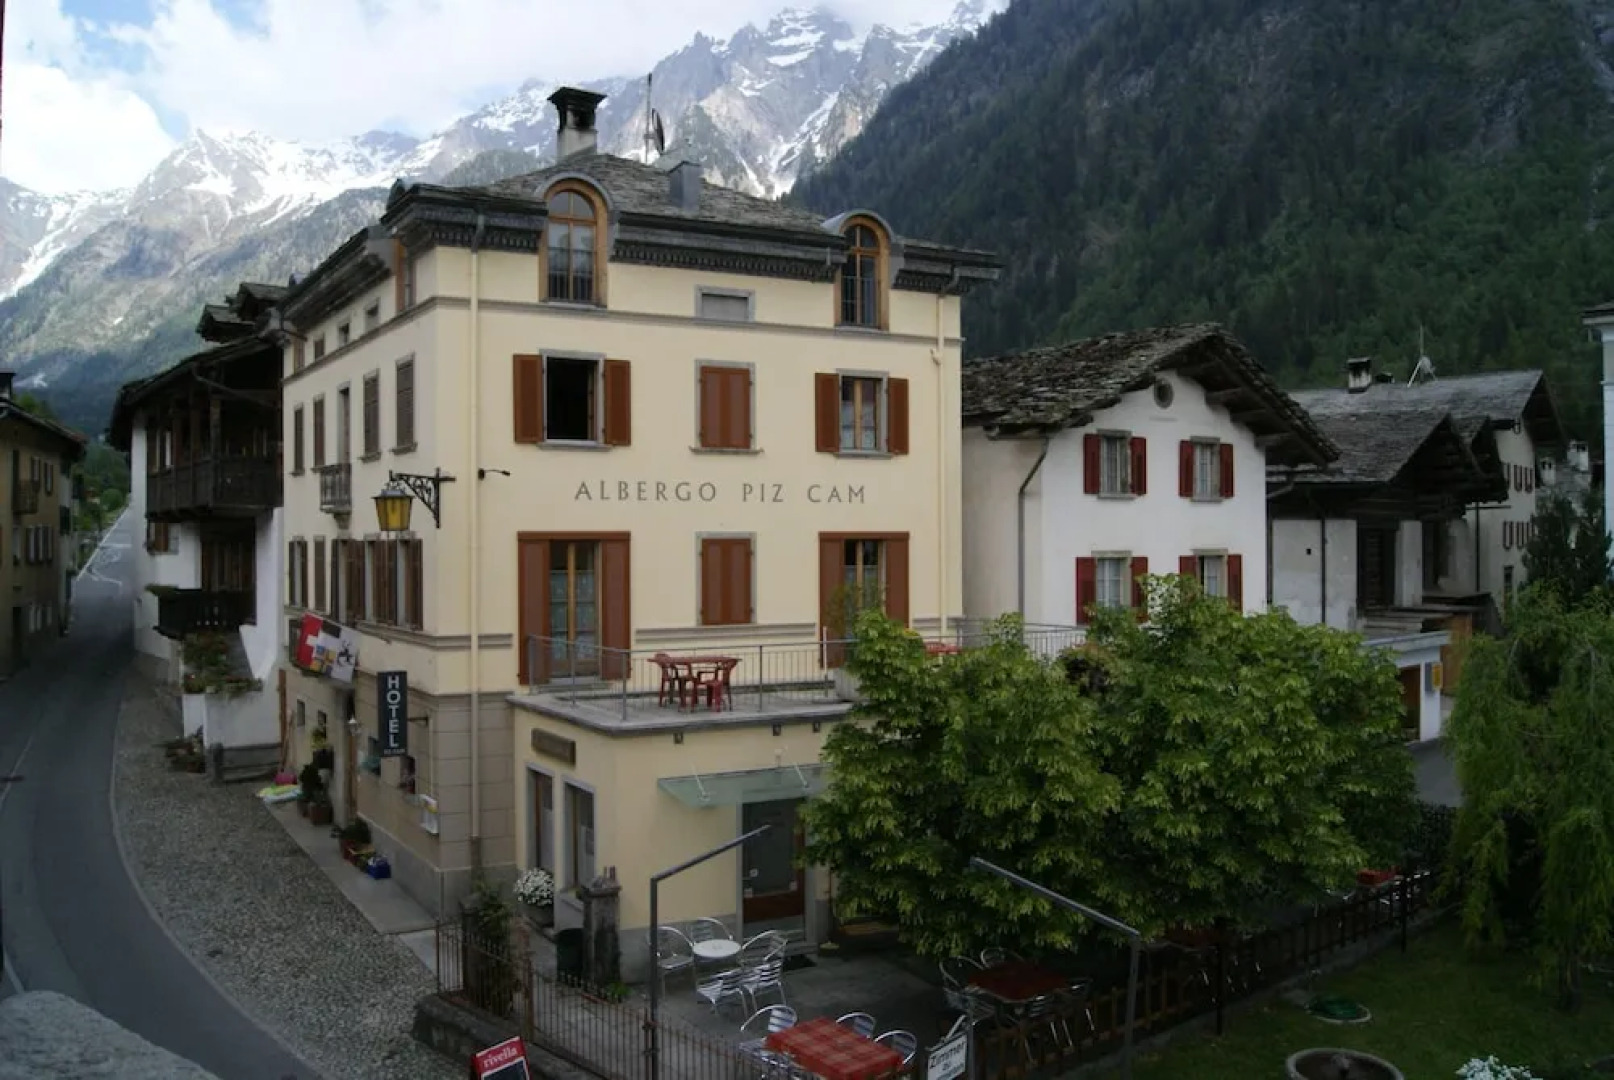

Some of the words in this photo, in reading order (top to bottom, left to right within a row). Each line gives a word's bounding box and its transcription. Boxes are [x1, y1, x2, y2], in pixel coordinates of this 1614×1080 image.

[574, 480, 717, 502] ALBERGO
[742, 483, 784, 503] PIZ
[807, 484, 865, 504] CAM
[386, 675, 401, 748] HOTEL
